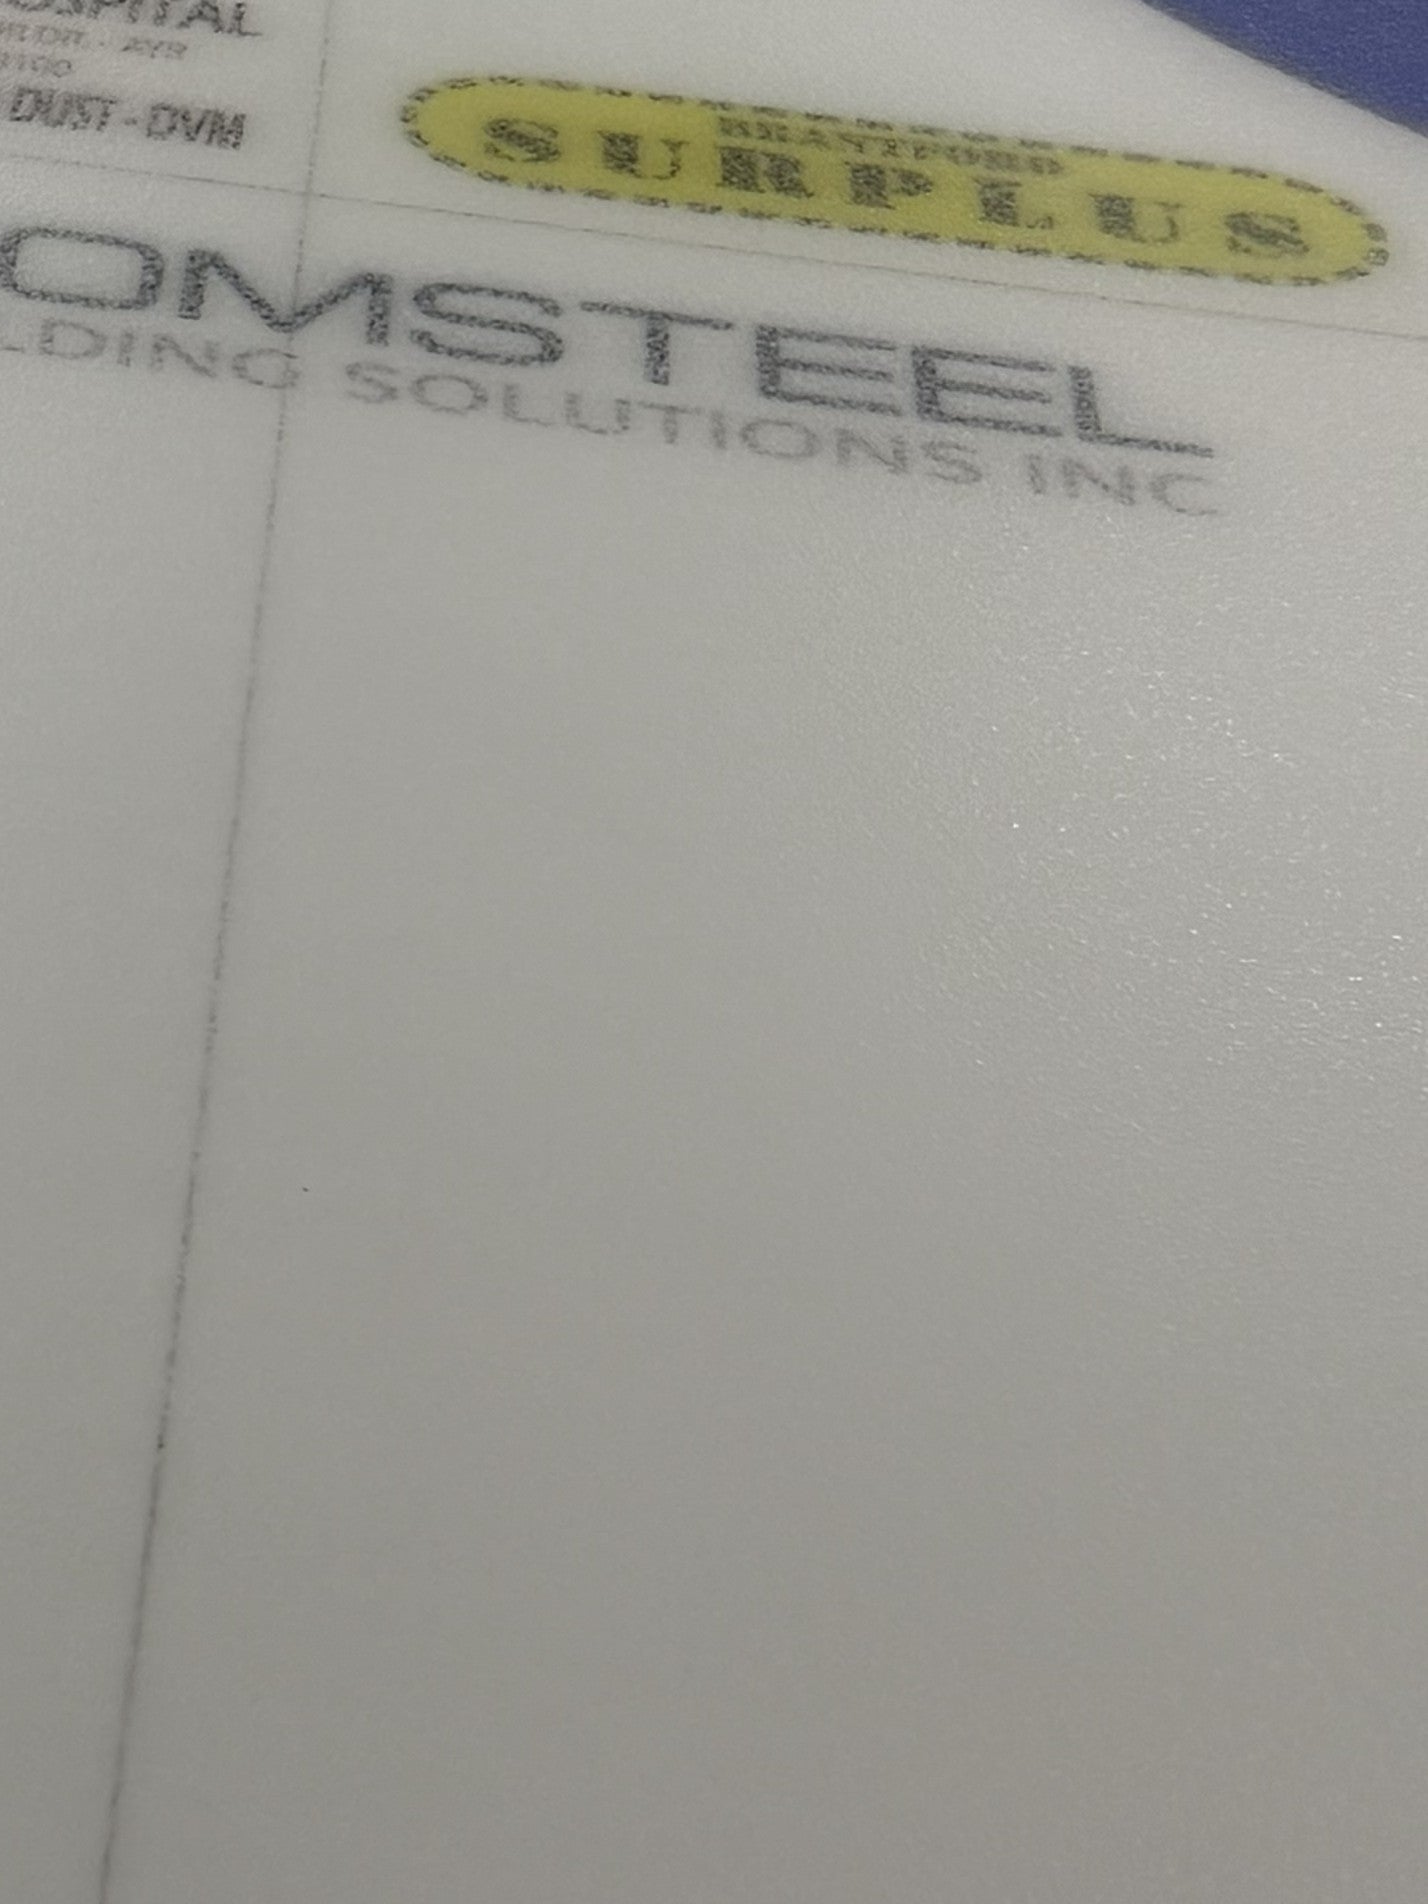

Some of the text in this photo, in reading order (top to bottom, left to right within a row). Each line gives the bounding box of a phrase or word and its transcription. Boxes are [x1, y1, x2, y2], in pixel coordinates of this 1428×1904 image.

[482, 114, 1312, 262] SURPLUS
[343, 360, 984, 486] SOLUTIONS
[1024, 451, 1220, 518] INC
